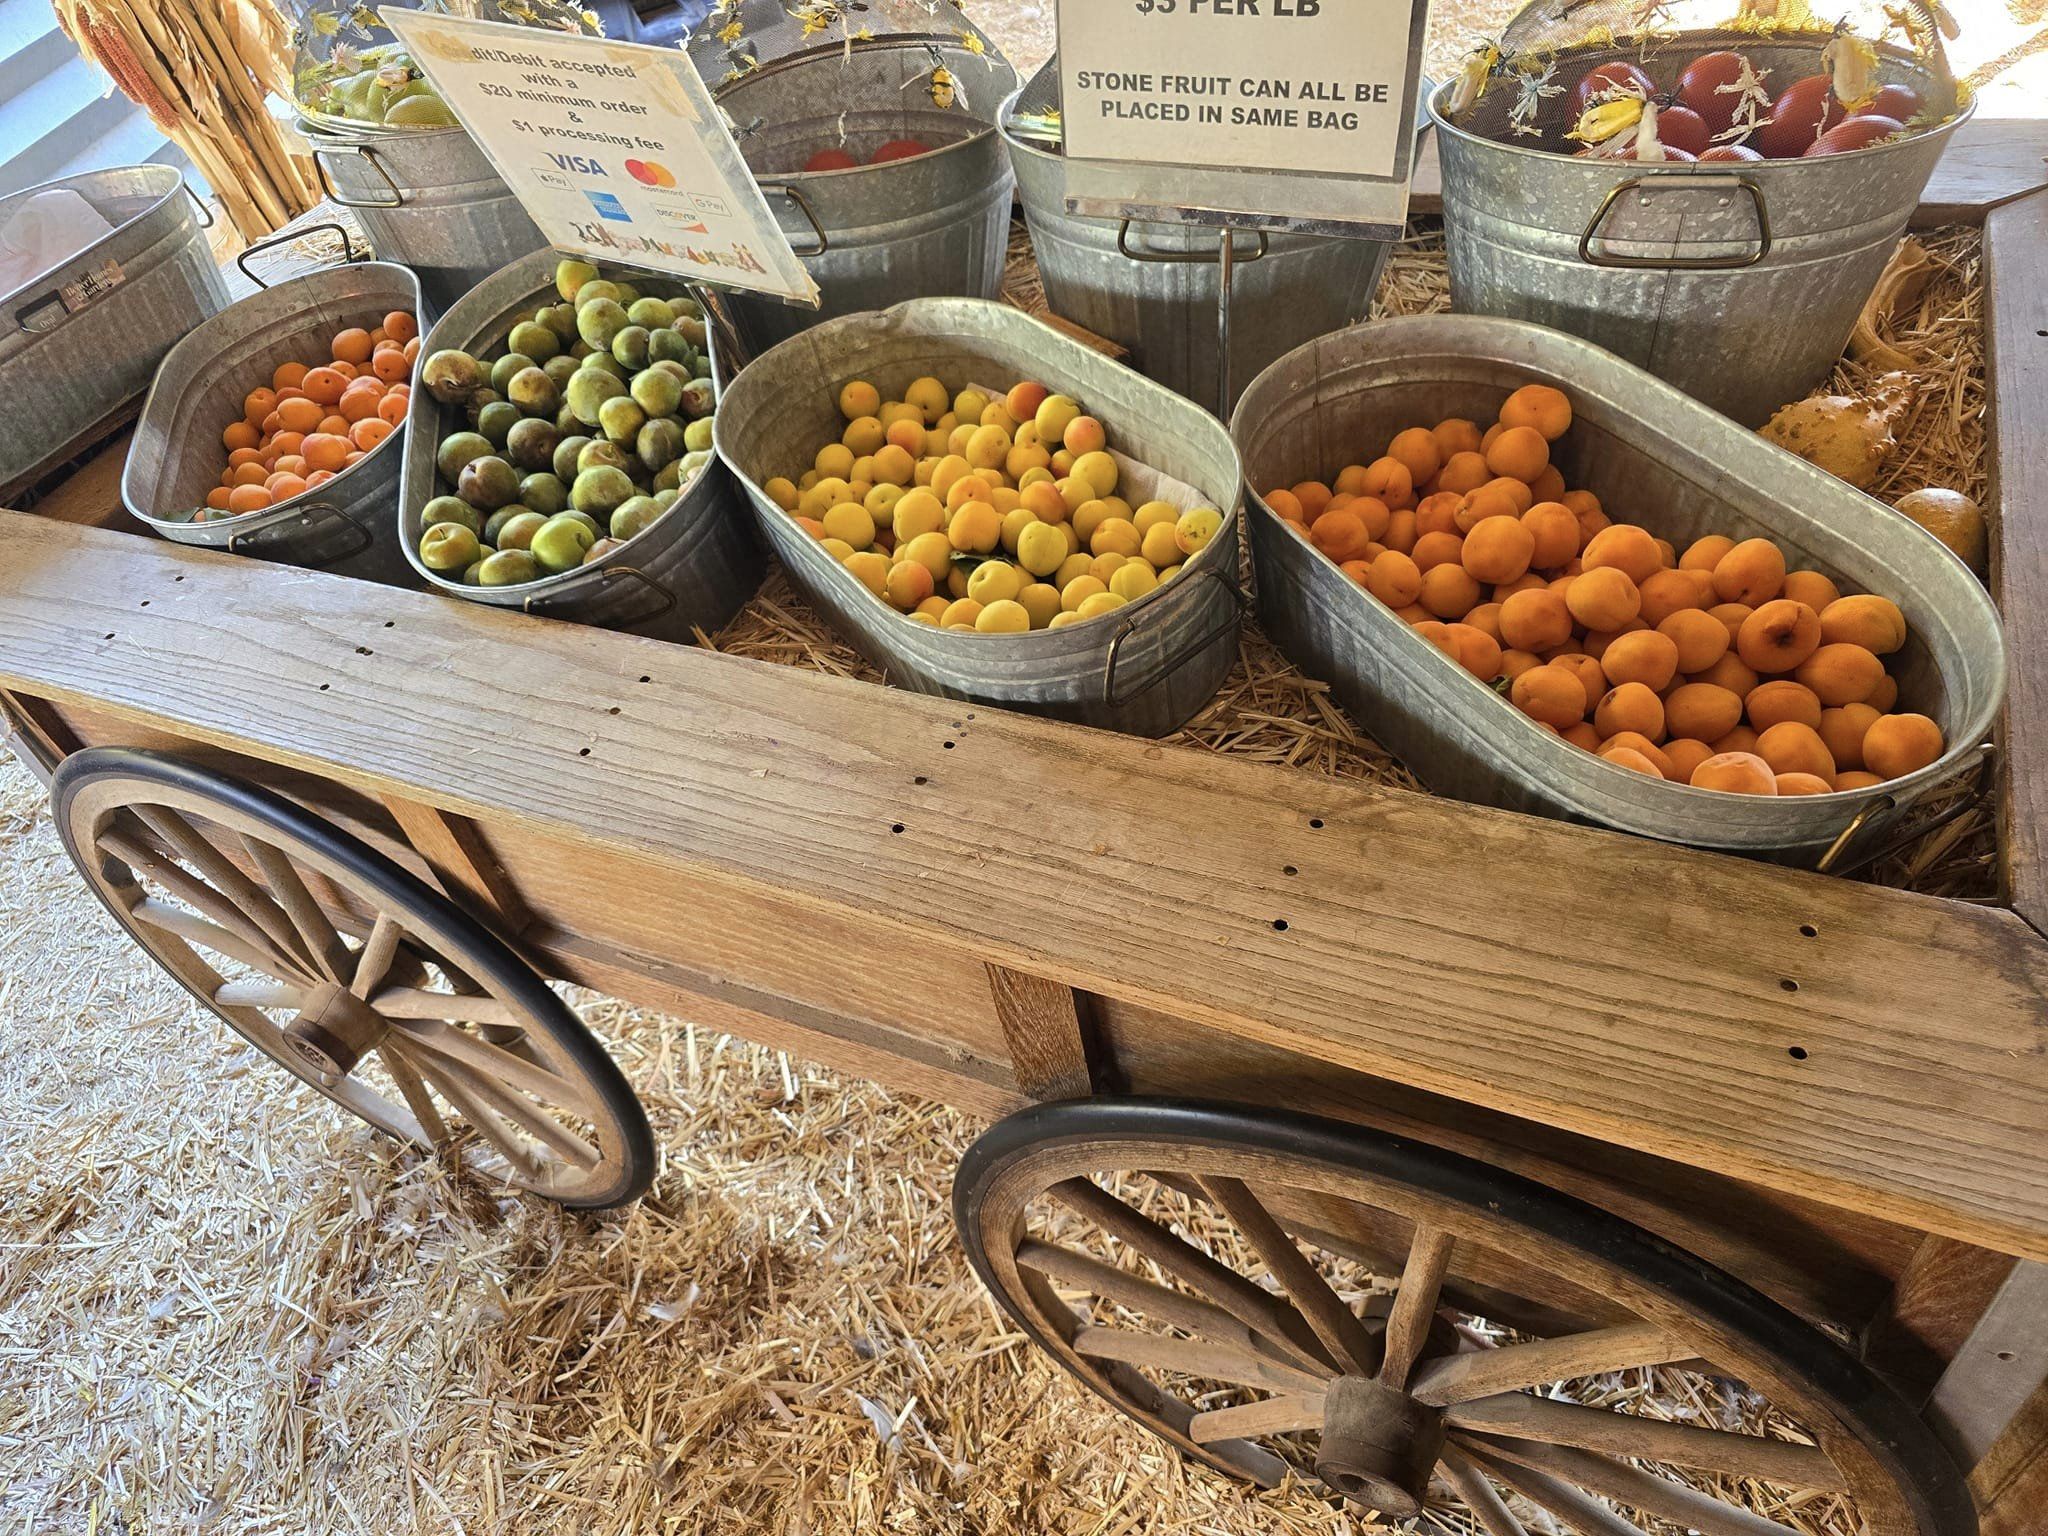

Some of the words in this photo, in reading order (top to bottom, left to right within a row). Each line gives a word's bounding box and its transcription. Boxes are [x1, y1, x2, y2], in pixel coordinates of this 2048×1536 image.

[1189, 0, 1261, 15] PER
[1273, 0, 1321, 17] LB
[521, 72, 562, 88] with
[566, 79, 579, 90] a
[549, 57, 637, 80] accepted
[478, 82, 513, 98] $20
[515, 88, 597, 109] minimum
[600, 100, 648, 116] order
[1076, 71, 1153, 93] STONE
[1161, 75, 1231, 96] FRUIT
[1239, 79, 1290, 99] CAN
[1298, 82, 1346, 101] ALL
[1355, 84, 1389, 103] BE
[567, 110, 584, 124] &
[1101, 100, 1190, 122] PLACED
[1199, 105, 1222, 124] IN
[1231, 107, 1298, 127] SAME
[1307, 110, 1359, 131] BAG
[512, 119, 534, 133] $1
[537, 124, 634, 149] processing
[634, 135, 665, 151] fee
[541, 151, 609, 178] VISA
